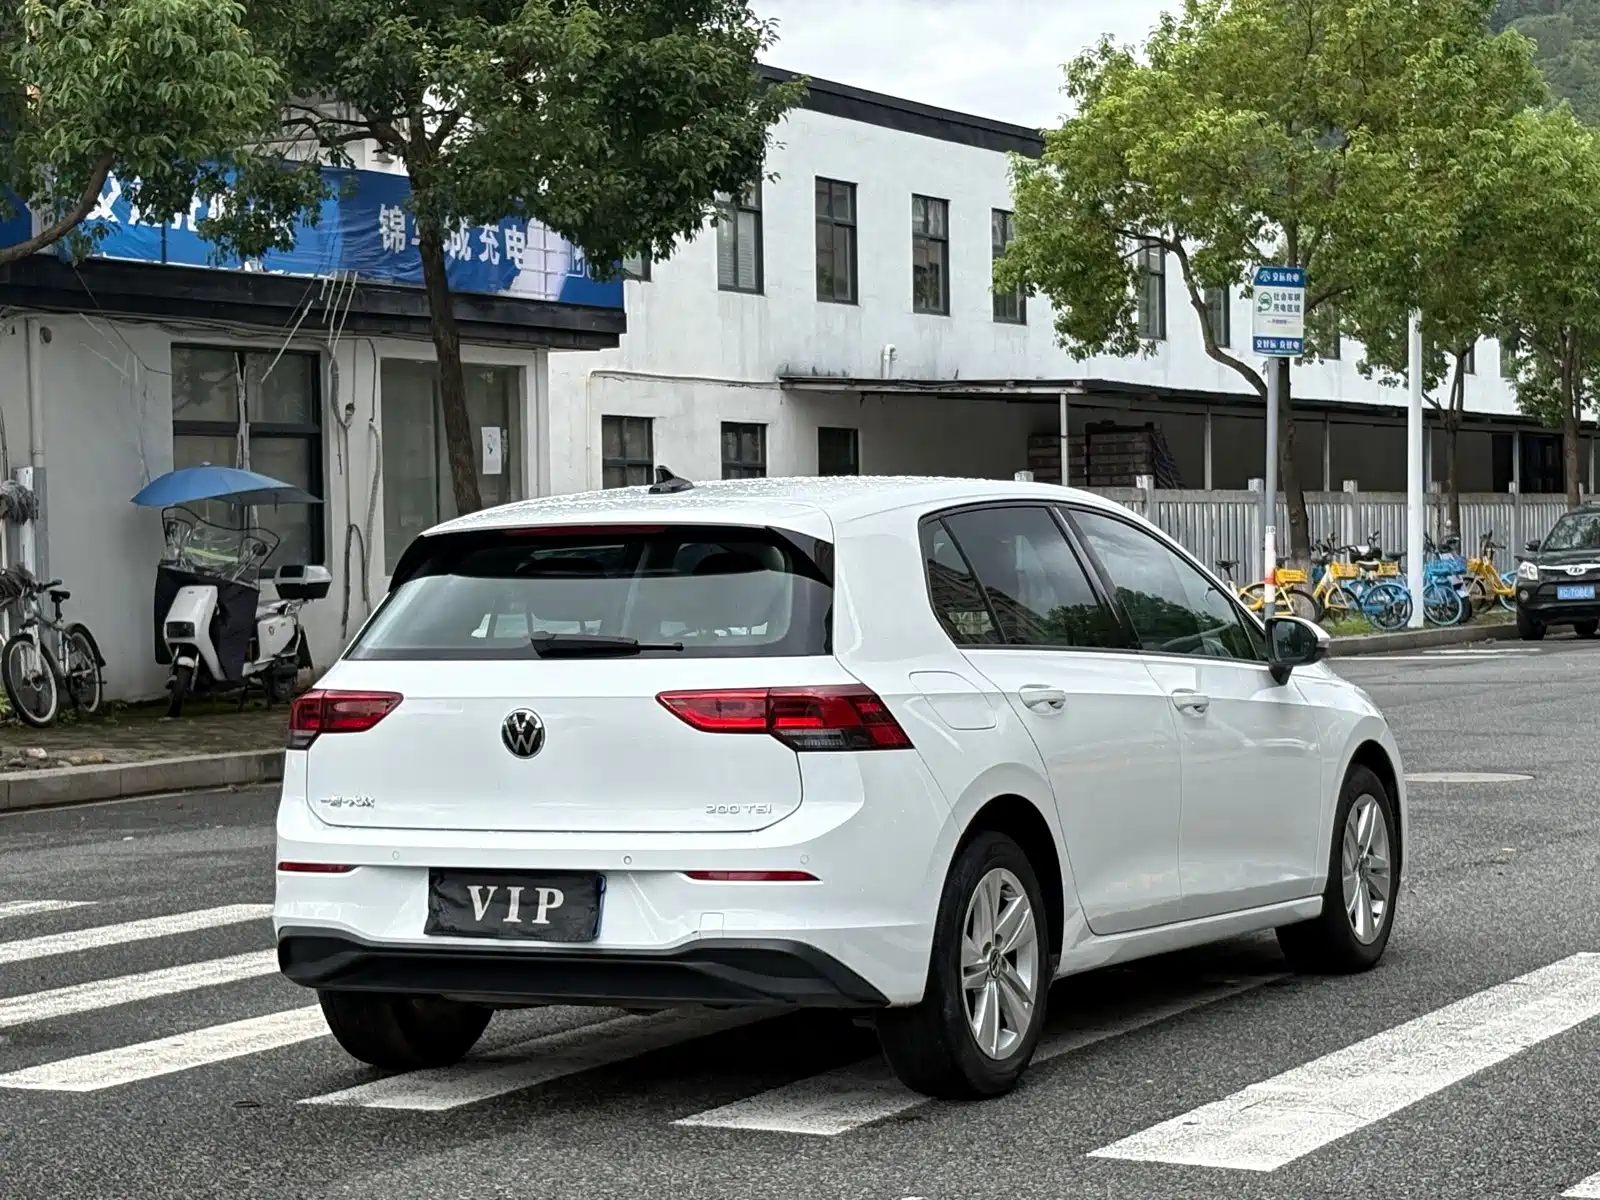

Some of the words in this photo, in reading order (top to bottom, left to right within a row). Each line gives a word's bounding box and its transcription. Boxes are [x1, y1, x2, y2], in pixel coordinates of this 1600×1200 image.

[378, 203, 526, 270] 锦城充电
[704, 803, 741, 815] 200
[467, 885, 565, 925] VIP
